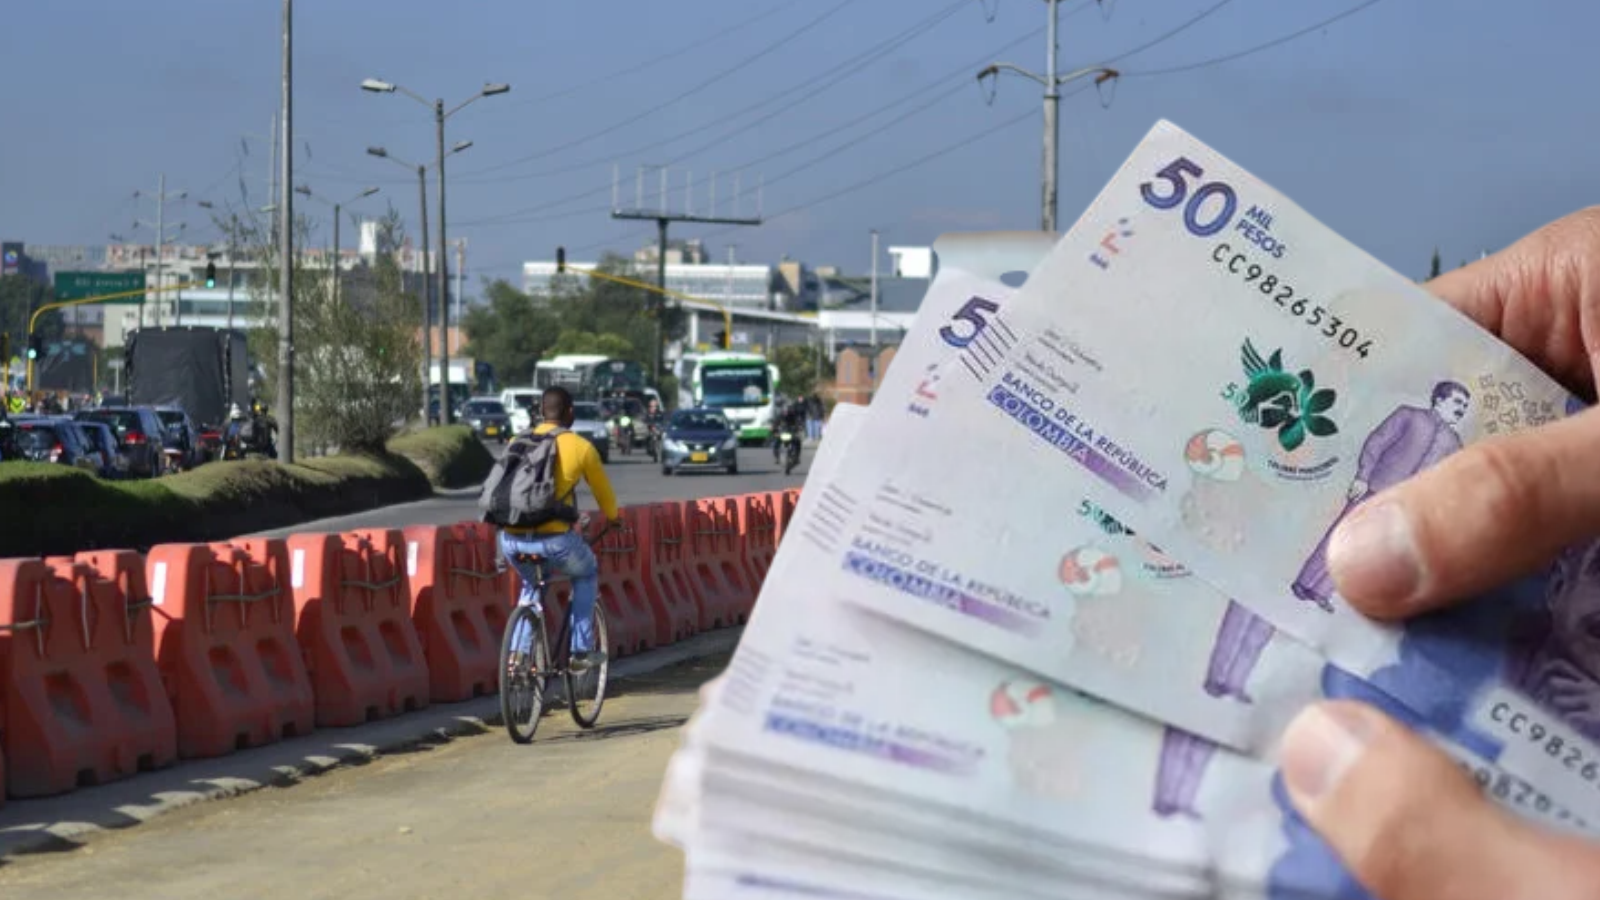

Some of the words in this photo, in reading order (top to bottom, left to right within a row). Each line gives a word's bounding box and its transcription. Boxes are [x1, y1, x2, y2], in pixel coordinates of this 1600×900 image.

[1140, 156, 1237, 237] 50
[1244, 205, 1275, 231] MIL
[1235, 219, 1286, 259] PESOS
[939, 296, 999, 348] 5
[1212, 243, 1374, 360] CC98265304
[989, 386, 1091, 464] COLOMBIA
[1002, 372, 1055, 412] BANCO
[1055, 408, 1076, 426] DE
[1075, 422, 1094, 442] LA
[1096, 435, 1168, 491] REPÚBLICA
[851, 536, 913, 567] BANCO
[916, 559, 938, 575] DE
[942, 568, 961, 584] LA
[1491, 702, 1600, 791] CC9826
